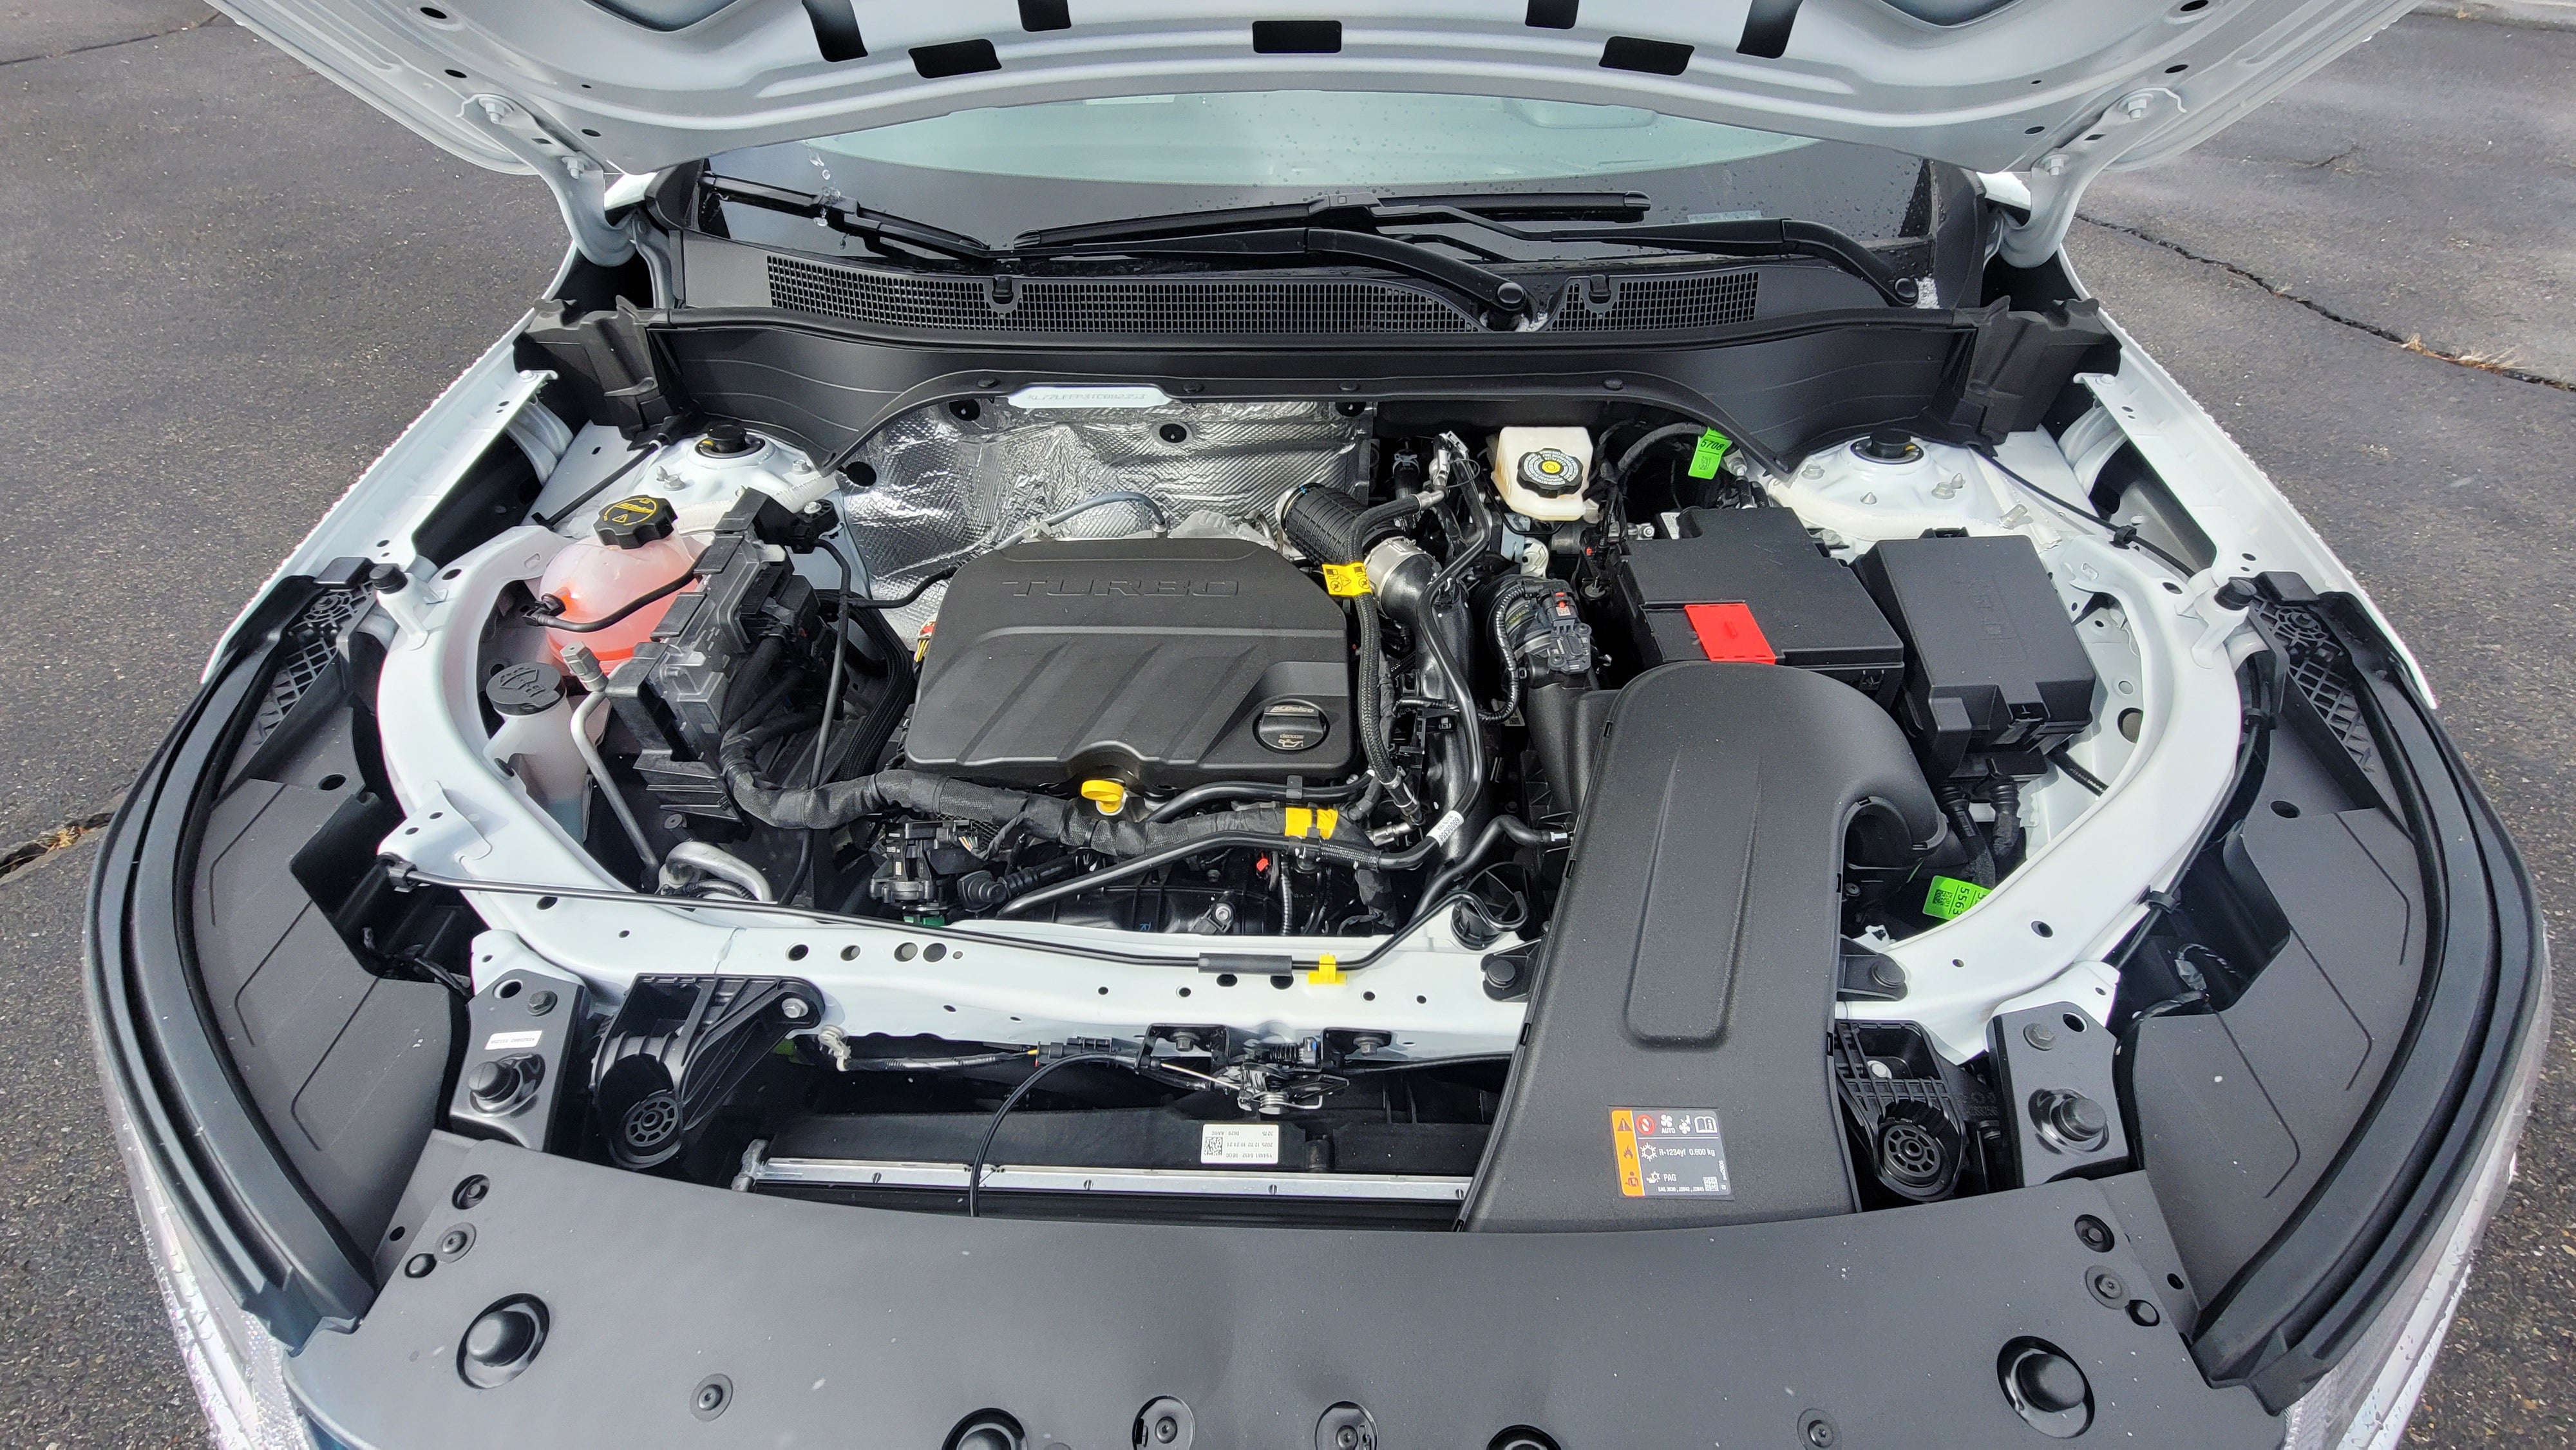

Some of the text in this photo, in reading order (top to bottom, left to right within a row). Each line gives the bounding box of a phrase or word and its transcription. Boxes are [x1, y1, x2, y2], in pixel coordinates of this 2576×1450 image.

[1701, 439, 1725, 450] 5708
[1001, 579, 1238, 596] TURBO
[1952, 887, 1969, 916] 5563
[1659, 1149, 1686, 1157] R-1234yf
[1707, 1148, 1716, 1157] kg
[1663, 1173, 1677, 1182] PAG
